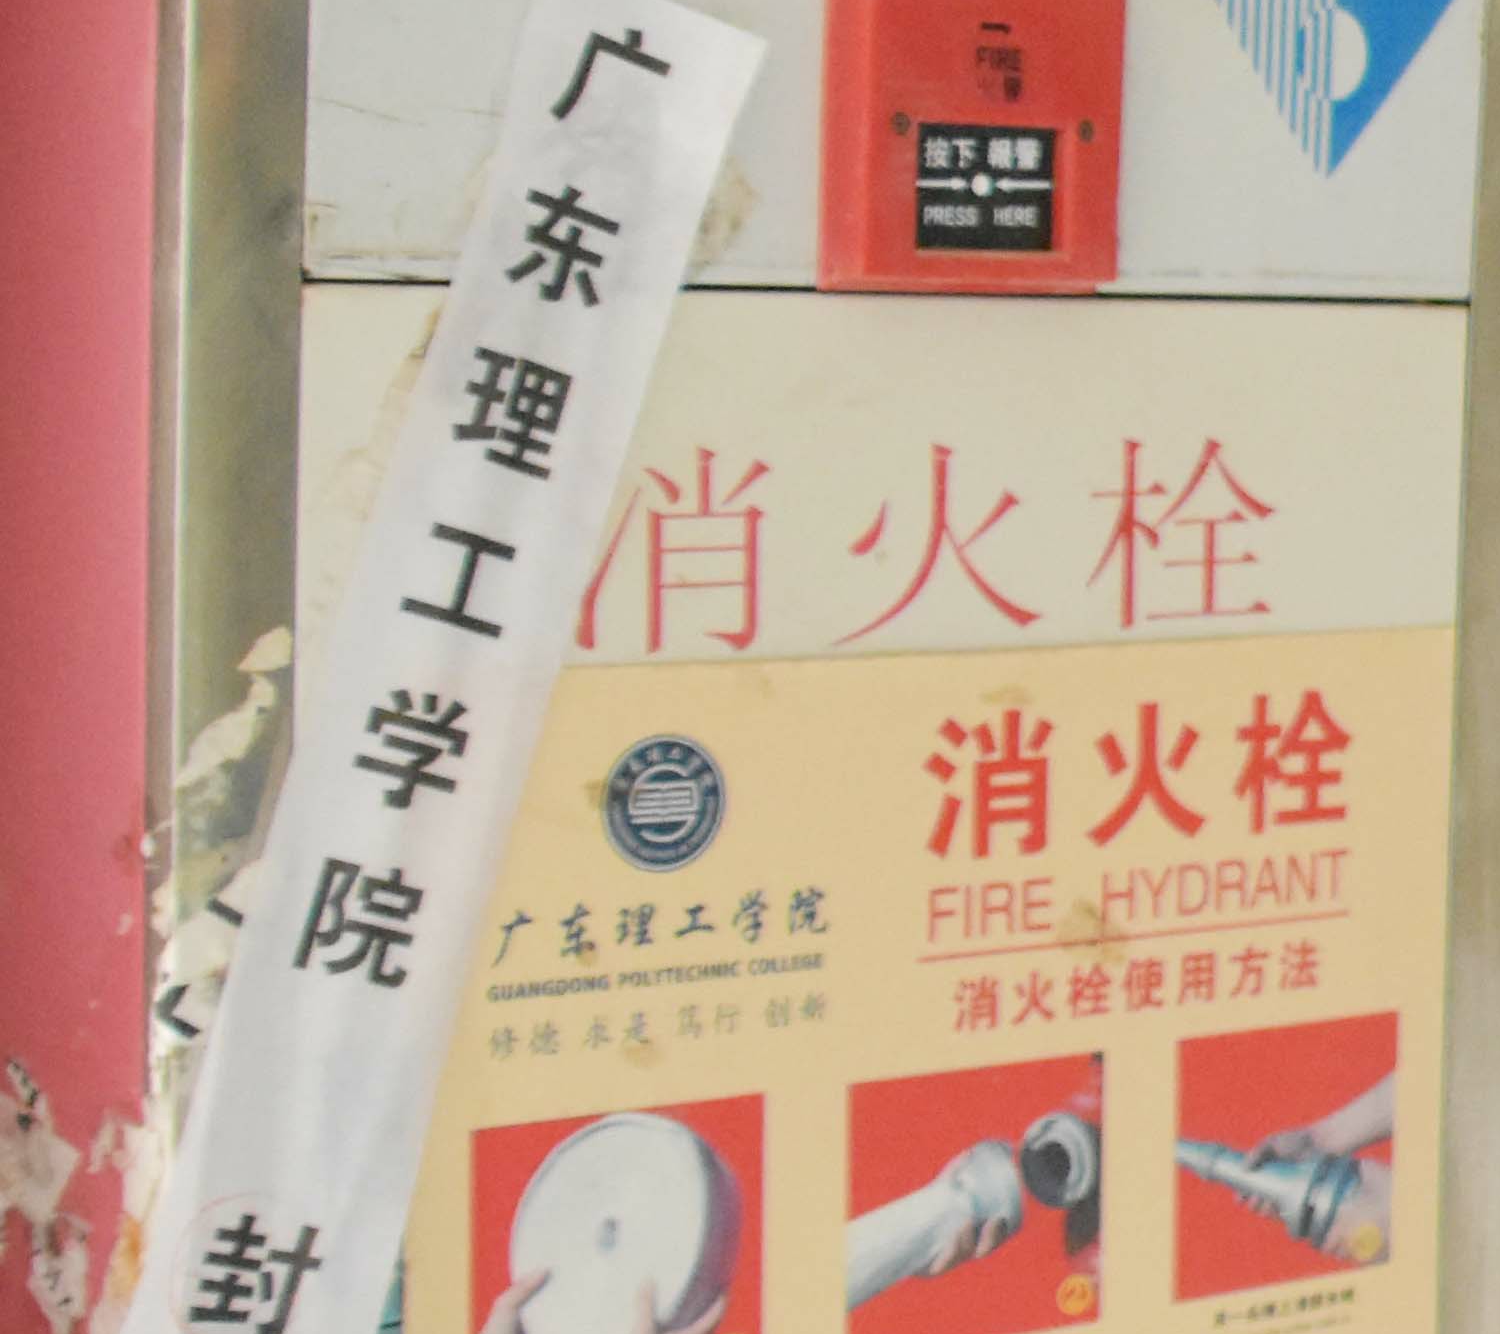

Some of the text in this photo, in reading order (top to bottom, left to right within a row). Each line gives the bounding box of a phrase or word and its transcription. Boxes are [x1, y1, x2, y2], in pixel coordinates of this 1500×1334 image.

[922, 205, 1039, 228] PRESS HERE
[293, 28, 671, 989] 广东理工学院
[923, 687, 1353, 859] 消火栓
[490, 885, 831, 969] 广东理工学院
[926, 848, 1350, 944] FIRE HYDRANT
[487, 951, 825, 1002] GUANGDONG POLYTECHNIC COLLEGE
[953, 938, 1320, 1033] 消火栓使用方法
